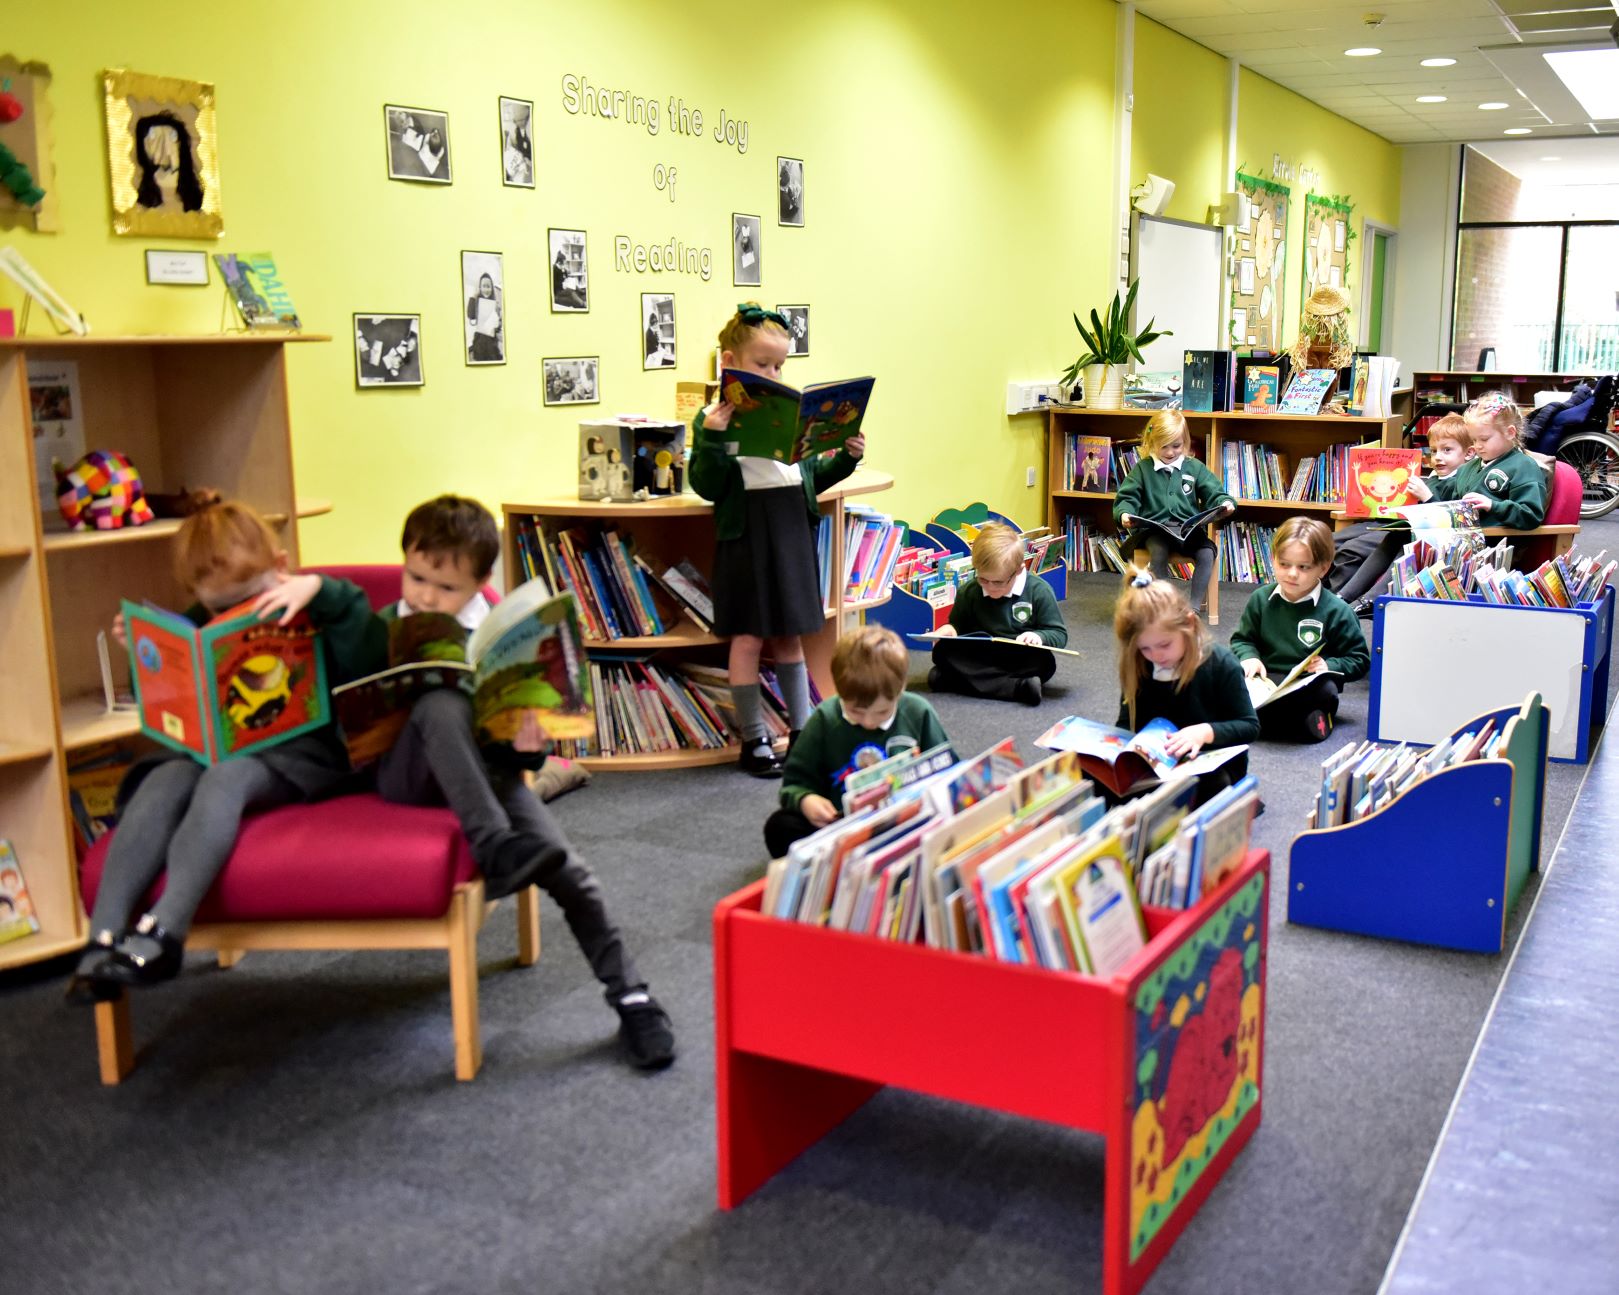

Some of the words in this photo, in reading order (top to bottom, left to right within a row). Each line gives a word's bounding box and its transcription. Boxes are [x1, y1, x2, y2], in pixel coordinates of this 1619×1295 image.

[562, 74, 659, 136] Sharing
[668, 96, 704, 137] the
[714, 109, 749, 154] Joy
[614, 235, 712, 281] Reading
[1291, 385, 1322, 393] Fantastic
[1293, 392, 1312, 400] First
[1382, 449, 1400, 459] happy
